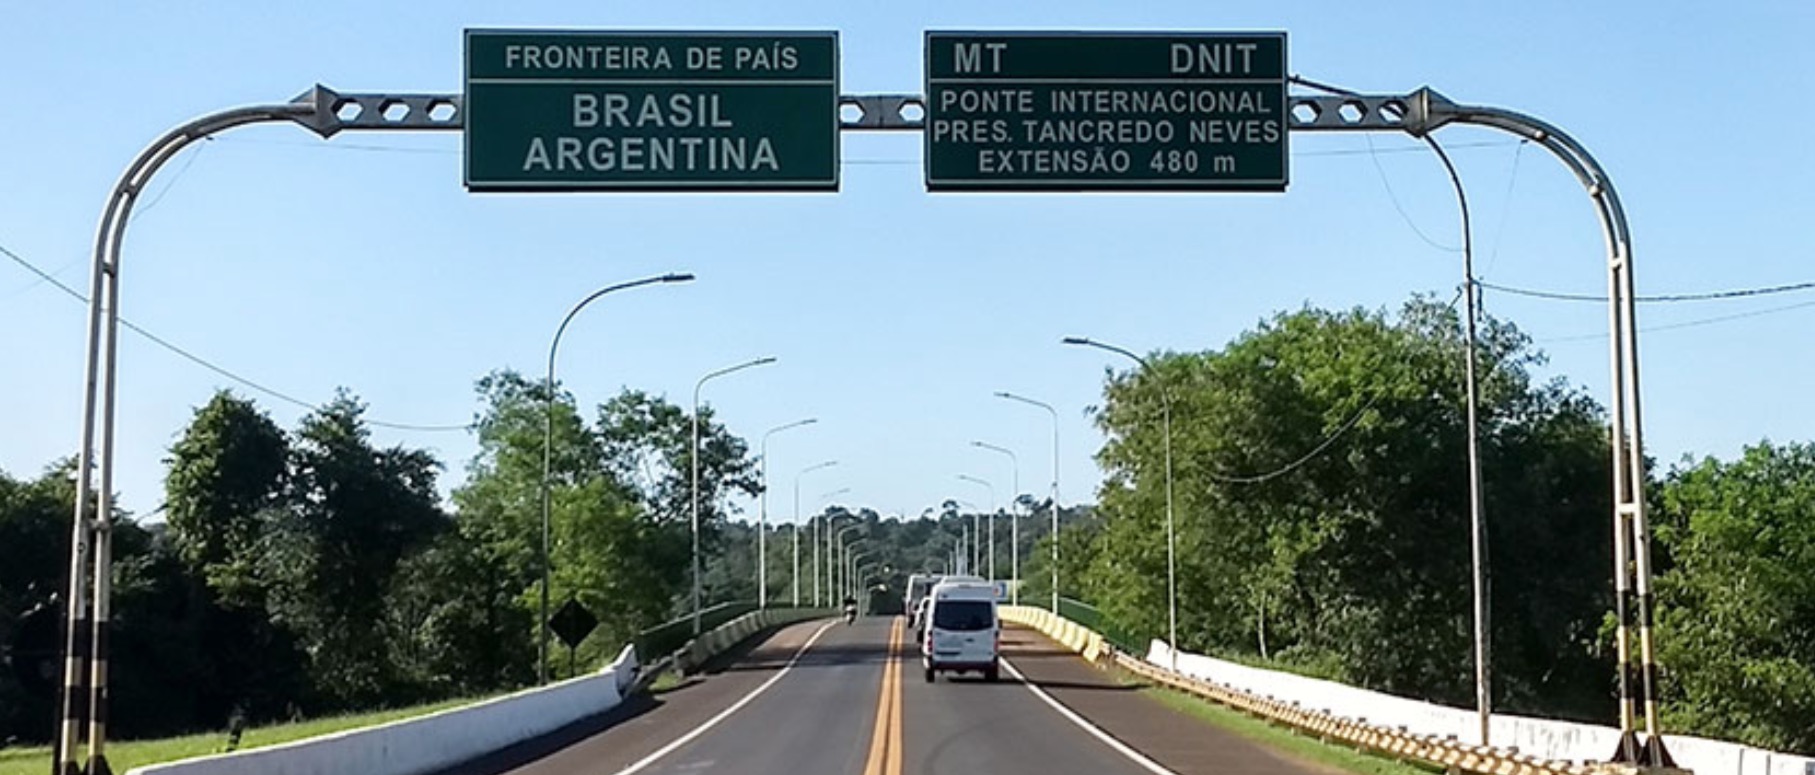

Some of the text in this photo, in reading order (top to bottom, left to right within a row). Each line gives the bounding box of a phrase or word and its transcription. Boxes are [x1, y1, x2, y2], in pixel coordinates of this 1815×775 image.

[506, 42, 799, 69] FRONTEIRA DE PAÍS
[955, 43, 1007, 73] MT
[1172, 44, 1257, 73] DNIT
[574, 94, 732, 127] BRASIL
[942, 91, 1271, 112] PONTE INTERNACIONAL
[935, 120, 1279, 142] PRES. TANCREDO NEVES
[523, 137, 779, 170] ARGENTINA
[979, 147, 1236, 172] EXTENSÃO 480 m
